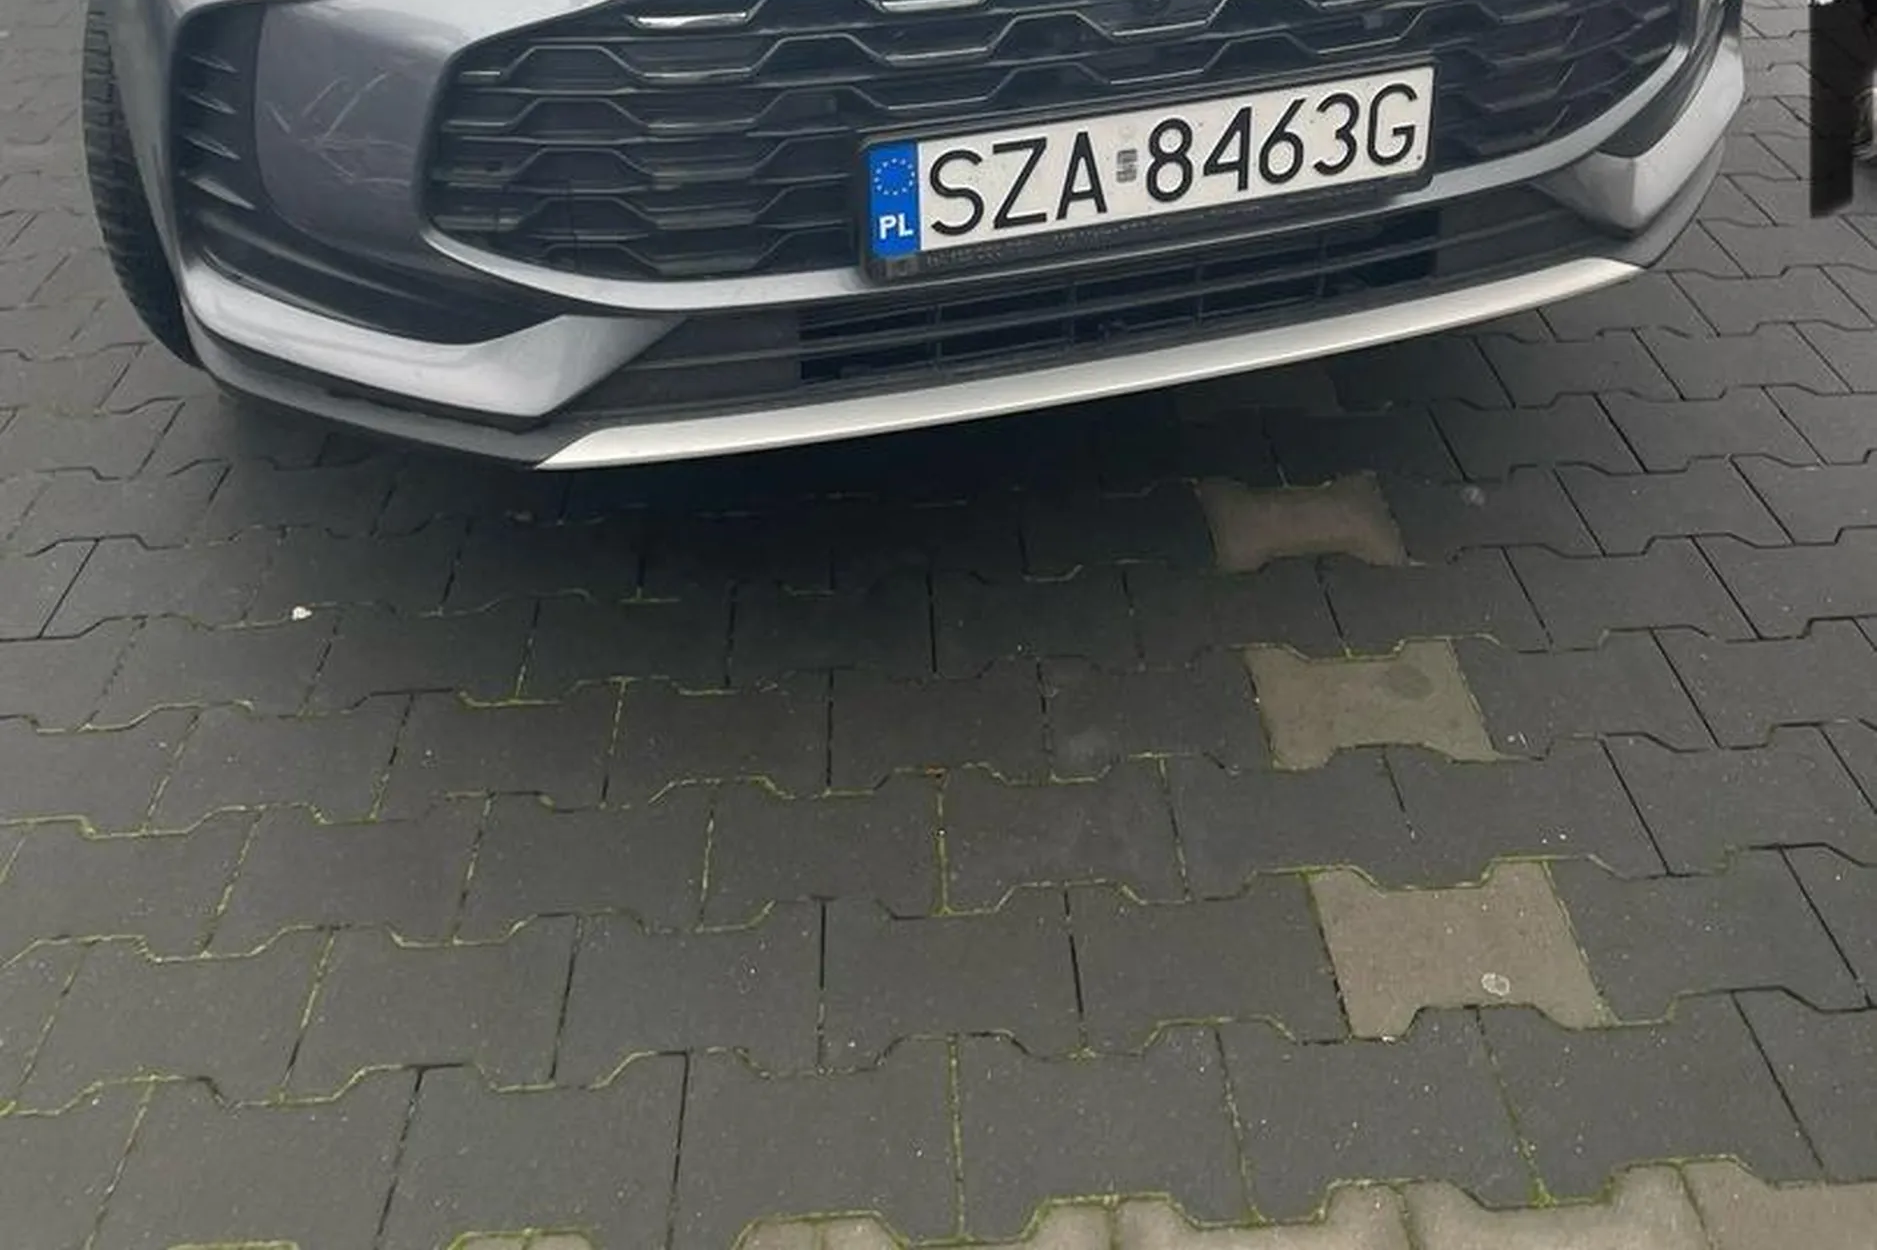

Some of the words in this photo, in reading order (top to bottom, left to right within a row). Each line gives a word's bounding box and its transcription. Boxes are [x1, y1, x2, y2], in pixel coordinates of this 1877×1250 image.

[929, 130, 1108, 237] SZA
[1145, 81, 1420, 204] 8463G
[878, 212, 915, 240] PL
